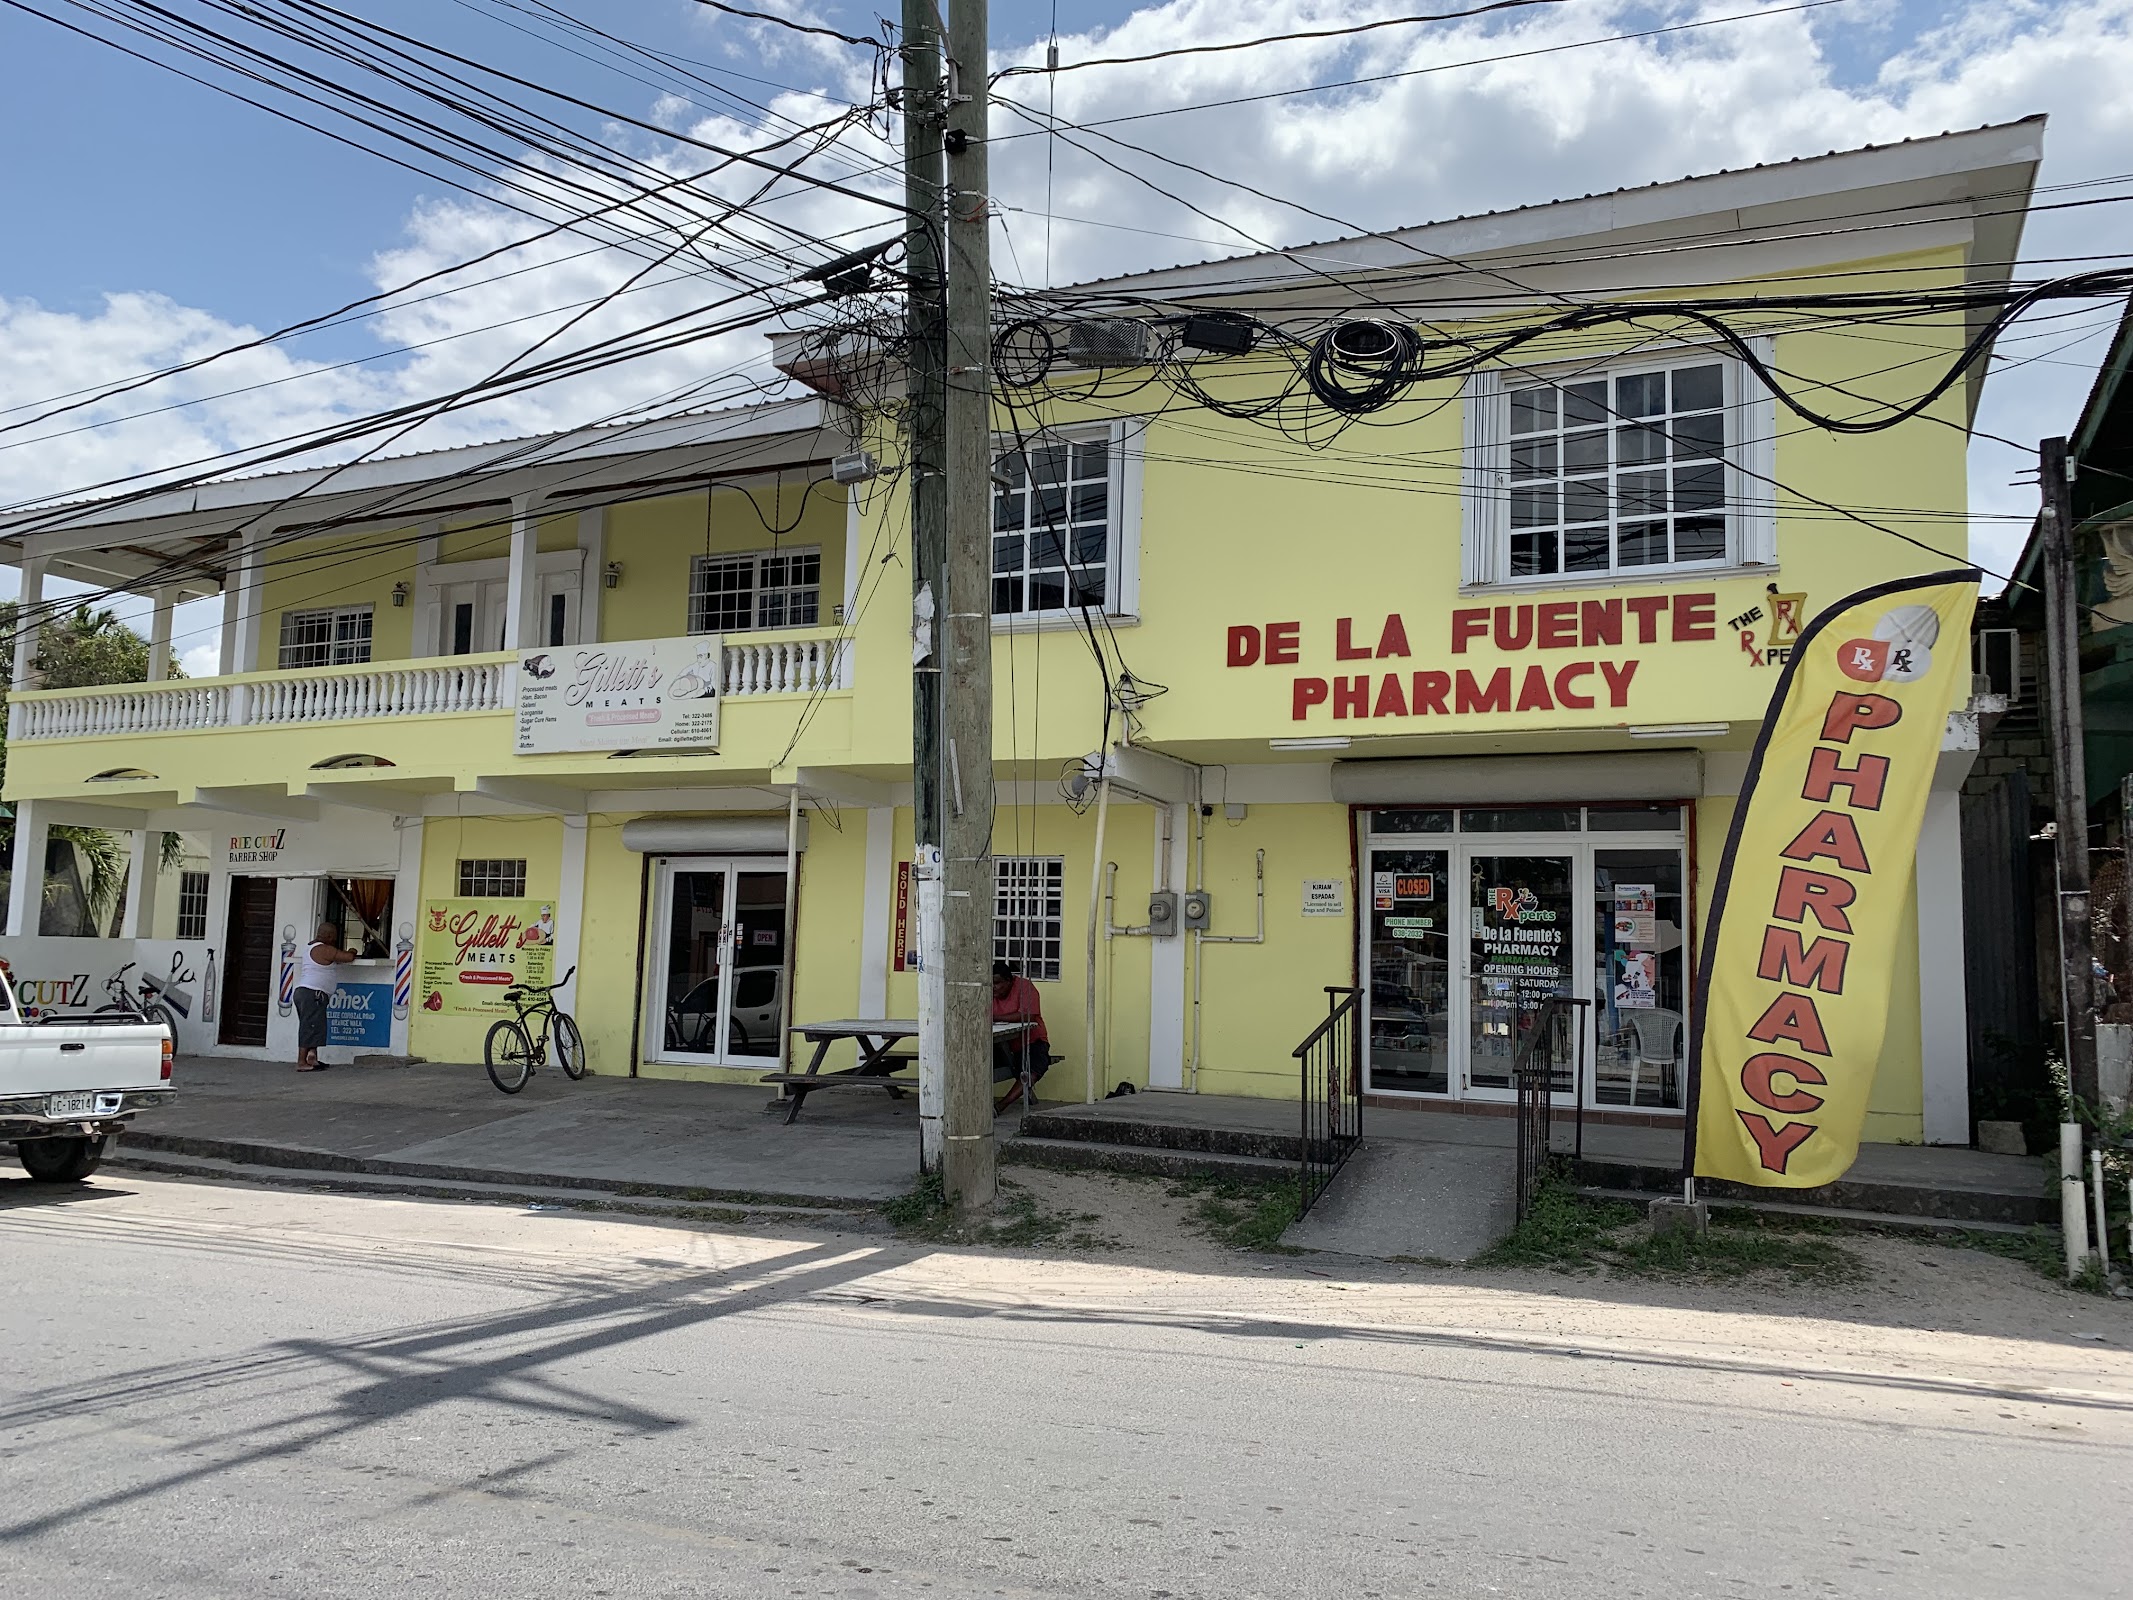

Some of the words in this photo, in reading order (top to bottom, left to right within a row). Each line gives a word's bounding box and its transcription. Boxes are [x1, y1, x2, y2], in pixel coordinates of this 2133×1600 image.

[1727, 606, 1764, 632] THE
[1227, 622, 1300, 667] DE
[1336, 614, 1411, 661] LA
[1451, 593, 1715, 653] FUENTE
[564, 645, 663, 706] Gillett's
[1292, 660, 1639, 720] PHARMACY
[585, 698, 662, 708] MEATS
[254, 829, 286, 849] CUTZ
[229, 852, 257, 862] BARBER
[258, 851, 278, 861] SHOP
[899, 871, 907, 909] SOLD
[1397, 879, 1430, 895] CLOSED
[1488, 889, 1496, 906] THE
[1386, 918, 1405, 926] PHONE
[450, 910, 526, 965] Gillett's
[897, 918, 905, 958] HERE
[1482, 926, 1497, 940] De
[1500, 927, 1511, 941] La
[1514, 927, 1561, 943] Fuente's
[1736, 691, 1901, 1174] PHARMACY
[468, 952, 515, 963] MEATS
[1484, 943, 1559, 956] PHARMACY
[1484, 964, 1524, 974] OPENING
[1527, 966, 1559, 975] HOURS
[18, 974, 90, 1007] CUTZ
[1520, 979, 1560, 988] SATURDAY
[1522, 990, 1540, 998] 12:00
[1542, 992, 1553, 1000] pm
